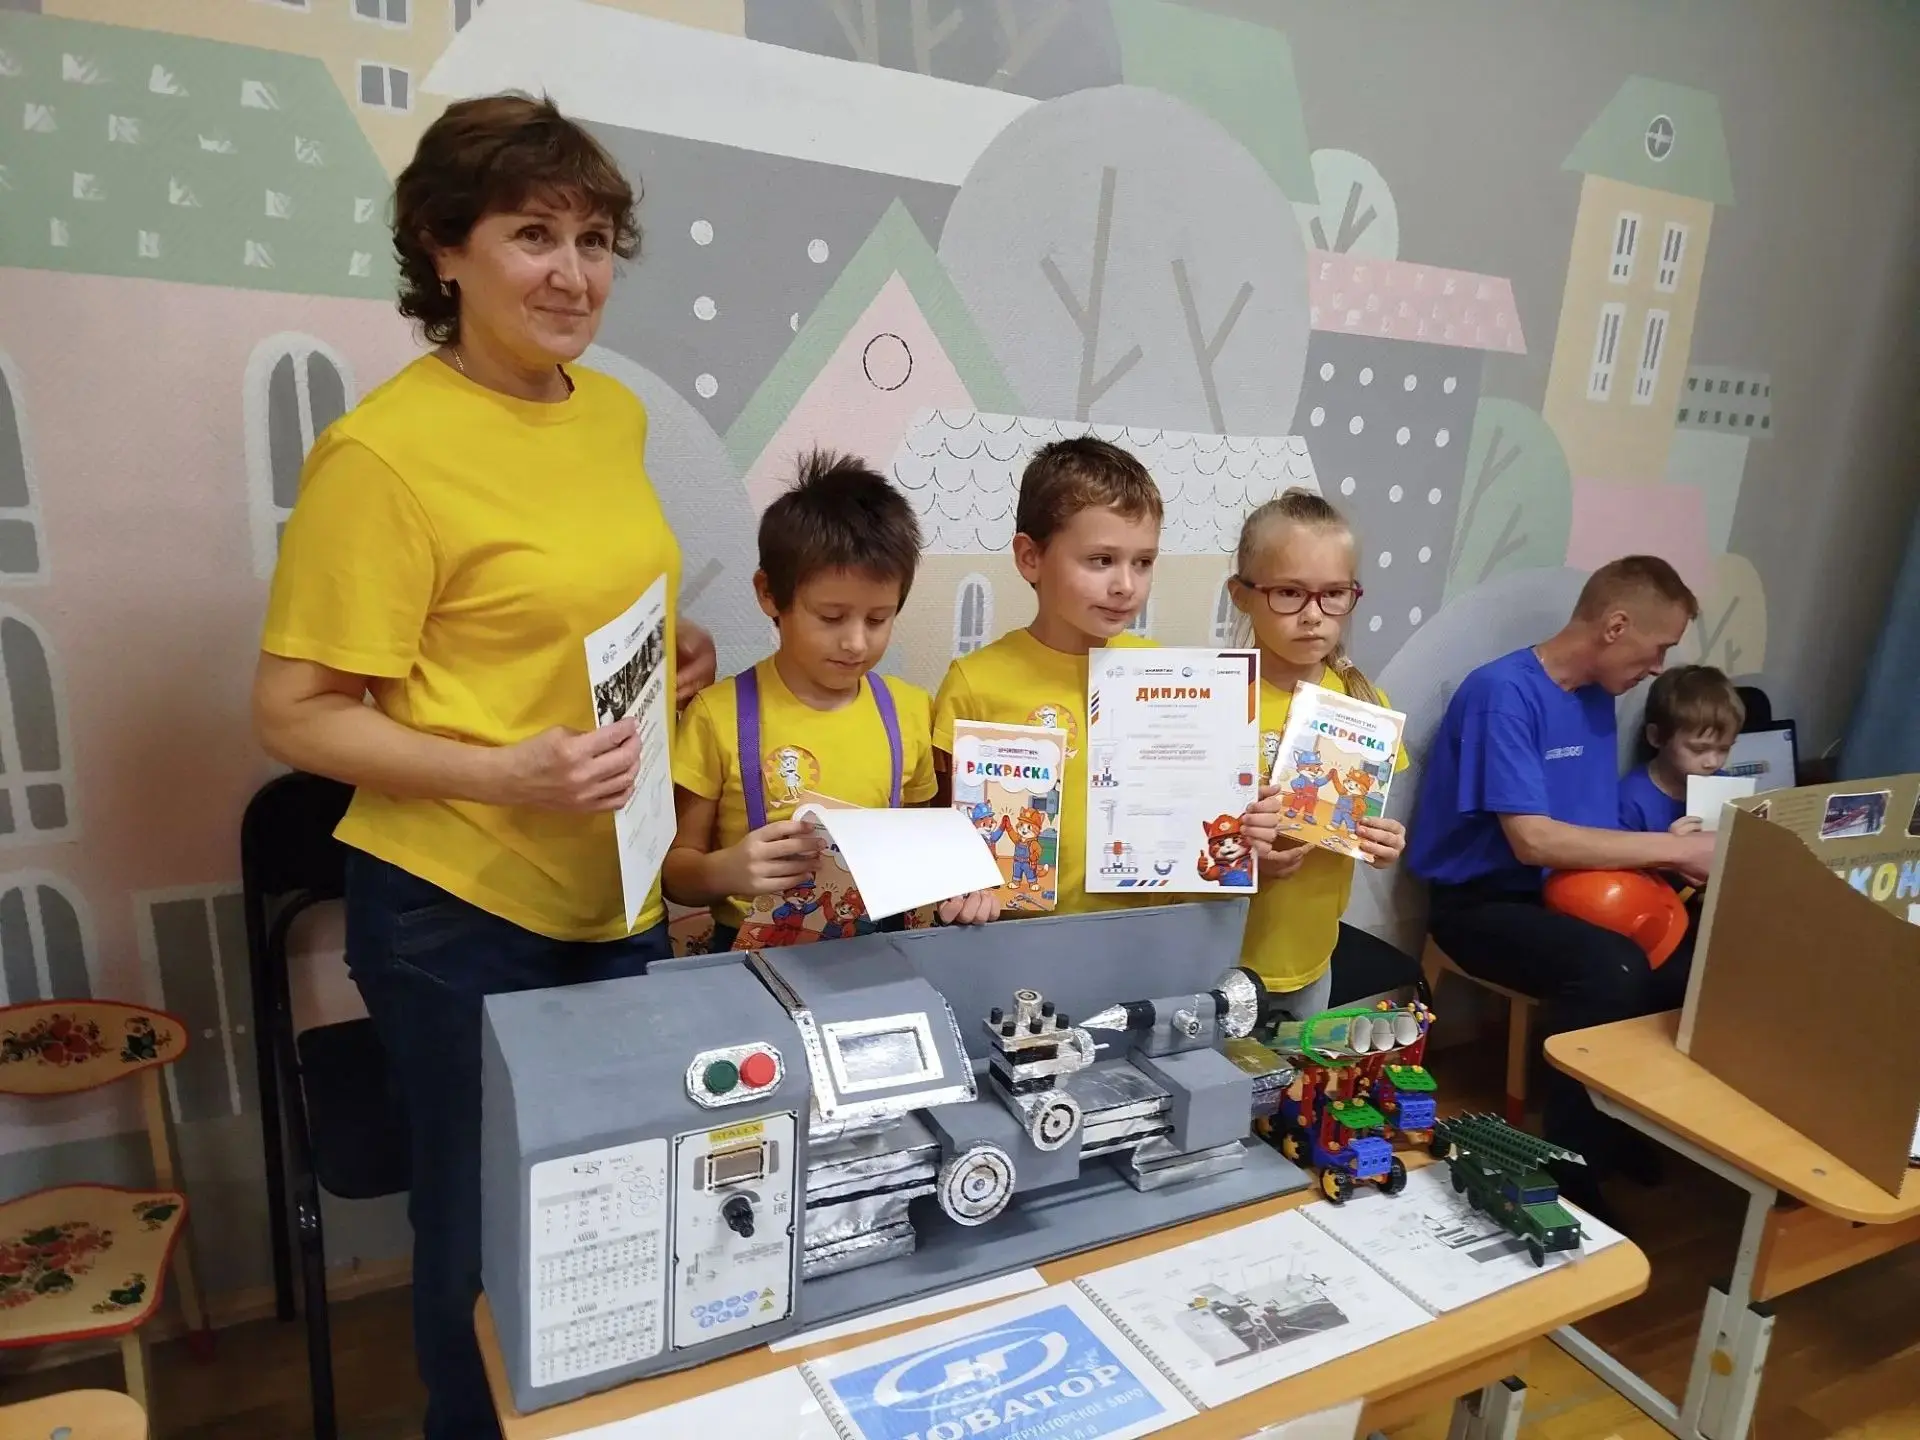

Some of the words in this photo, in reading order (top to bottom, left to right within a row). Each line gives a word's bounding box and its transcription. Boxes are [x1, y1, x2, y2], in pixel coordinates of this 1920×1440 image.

[1136, 687, 1211, 701] ДИПЛОМ
[1309, 719, 1385, 752] АСКРАСКА
[967, 761, 1050, 780] РАСКРАСКА
[901, 1364, 1121, 1440] ОВАТОР
[1108, 1388, 1145, 1408] БЮРО
